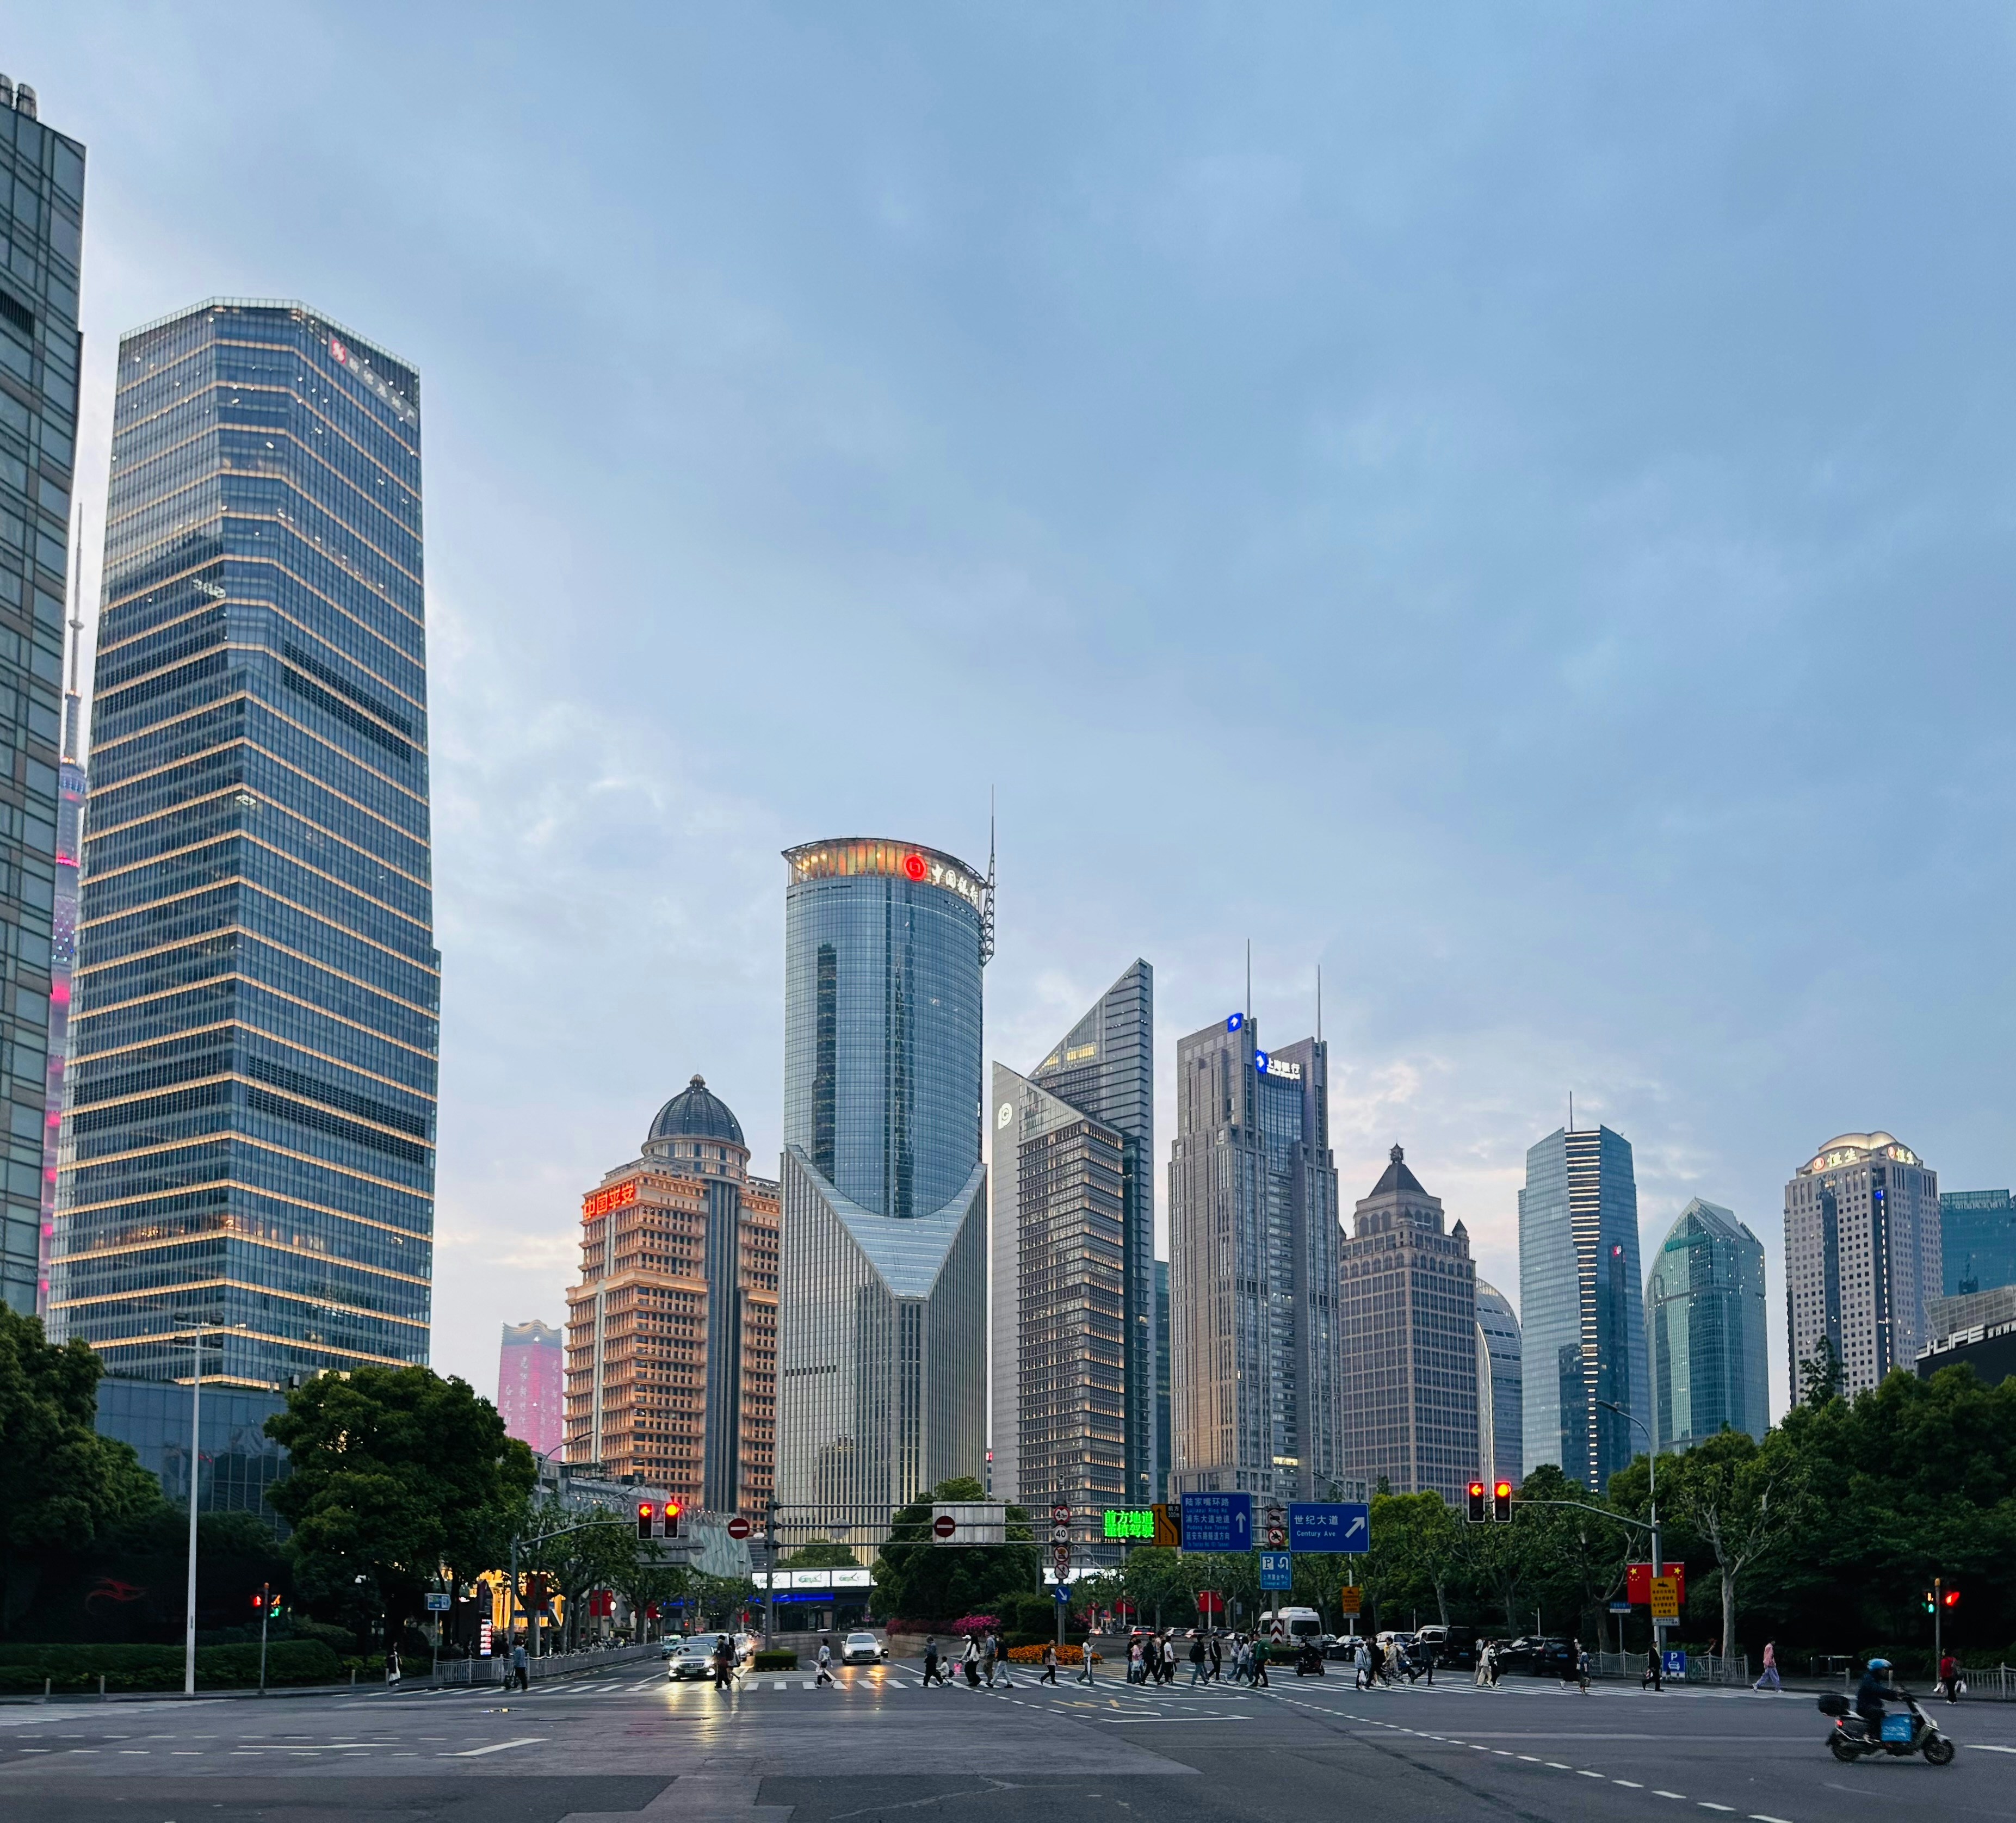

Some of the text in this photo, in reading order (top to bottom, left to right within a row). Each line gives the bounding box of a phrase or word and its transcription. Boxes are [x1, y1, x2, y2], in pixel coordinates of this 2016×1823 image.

[932, 864, 979, 905] 中国银行
[1827, 1148, 1857, 1167] 恒生
[1896, 1147, 1915, 1165] 恒生
[583, 1183, 634, 1219] 中国平安
[1185, 1498, 1229, 1506] 陆家嘴环路
[1104, 1510, 1154, 1524] 前方地道
[1185, 1515, 1230, 1524] 浦东大道地道
[1294, 1515, 1338, 1525] 世纪大道
[1056, 1530, 1066, 1538] 40
[1104, 1524, 1154, 1538] 谨慎驾驶
[1671, 1653, 1678, 1661] P
